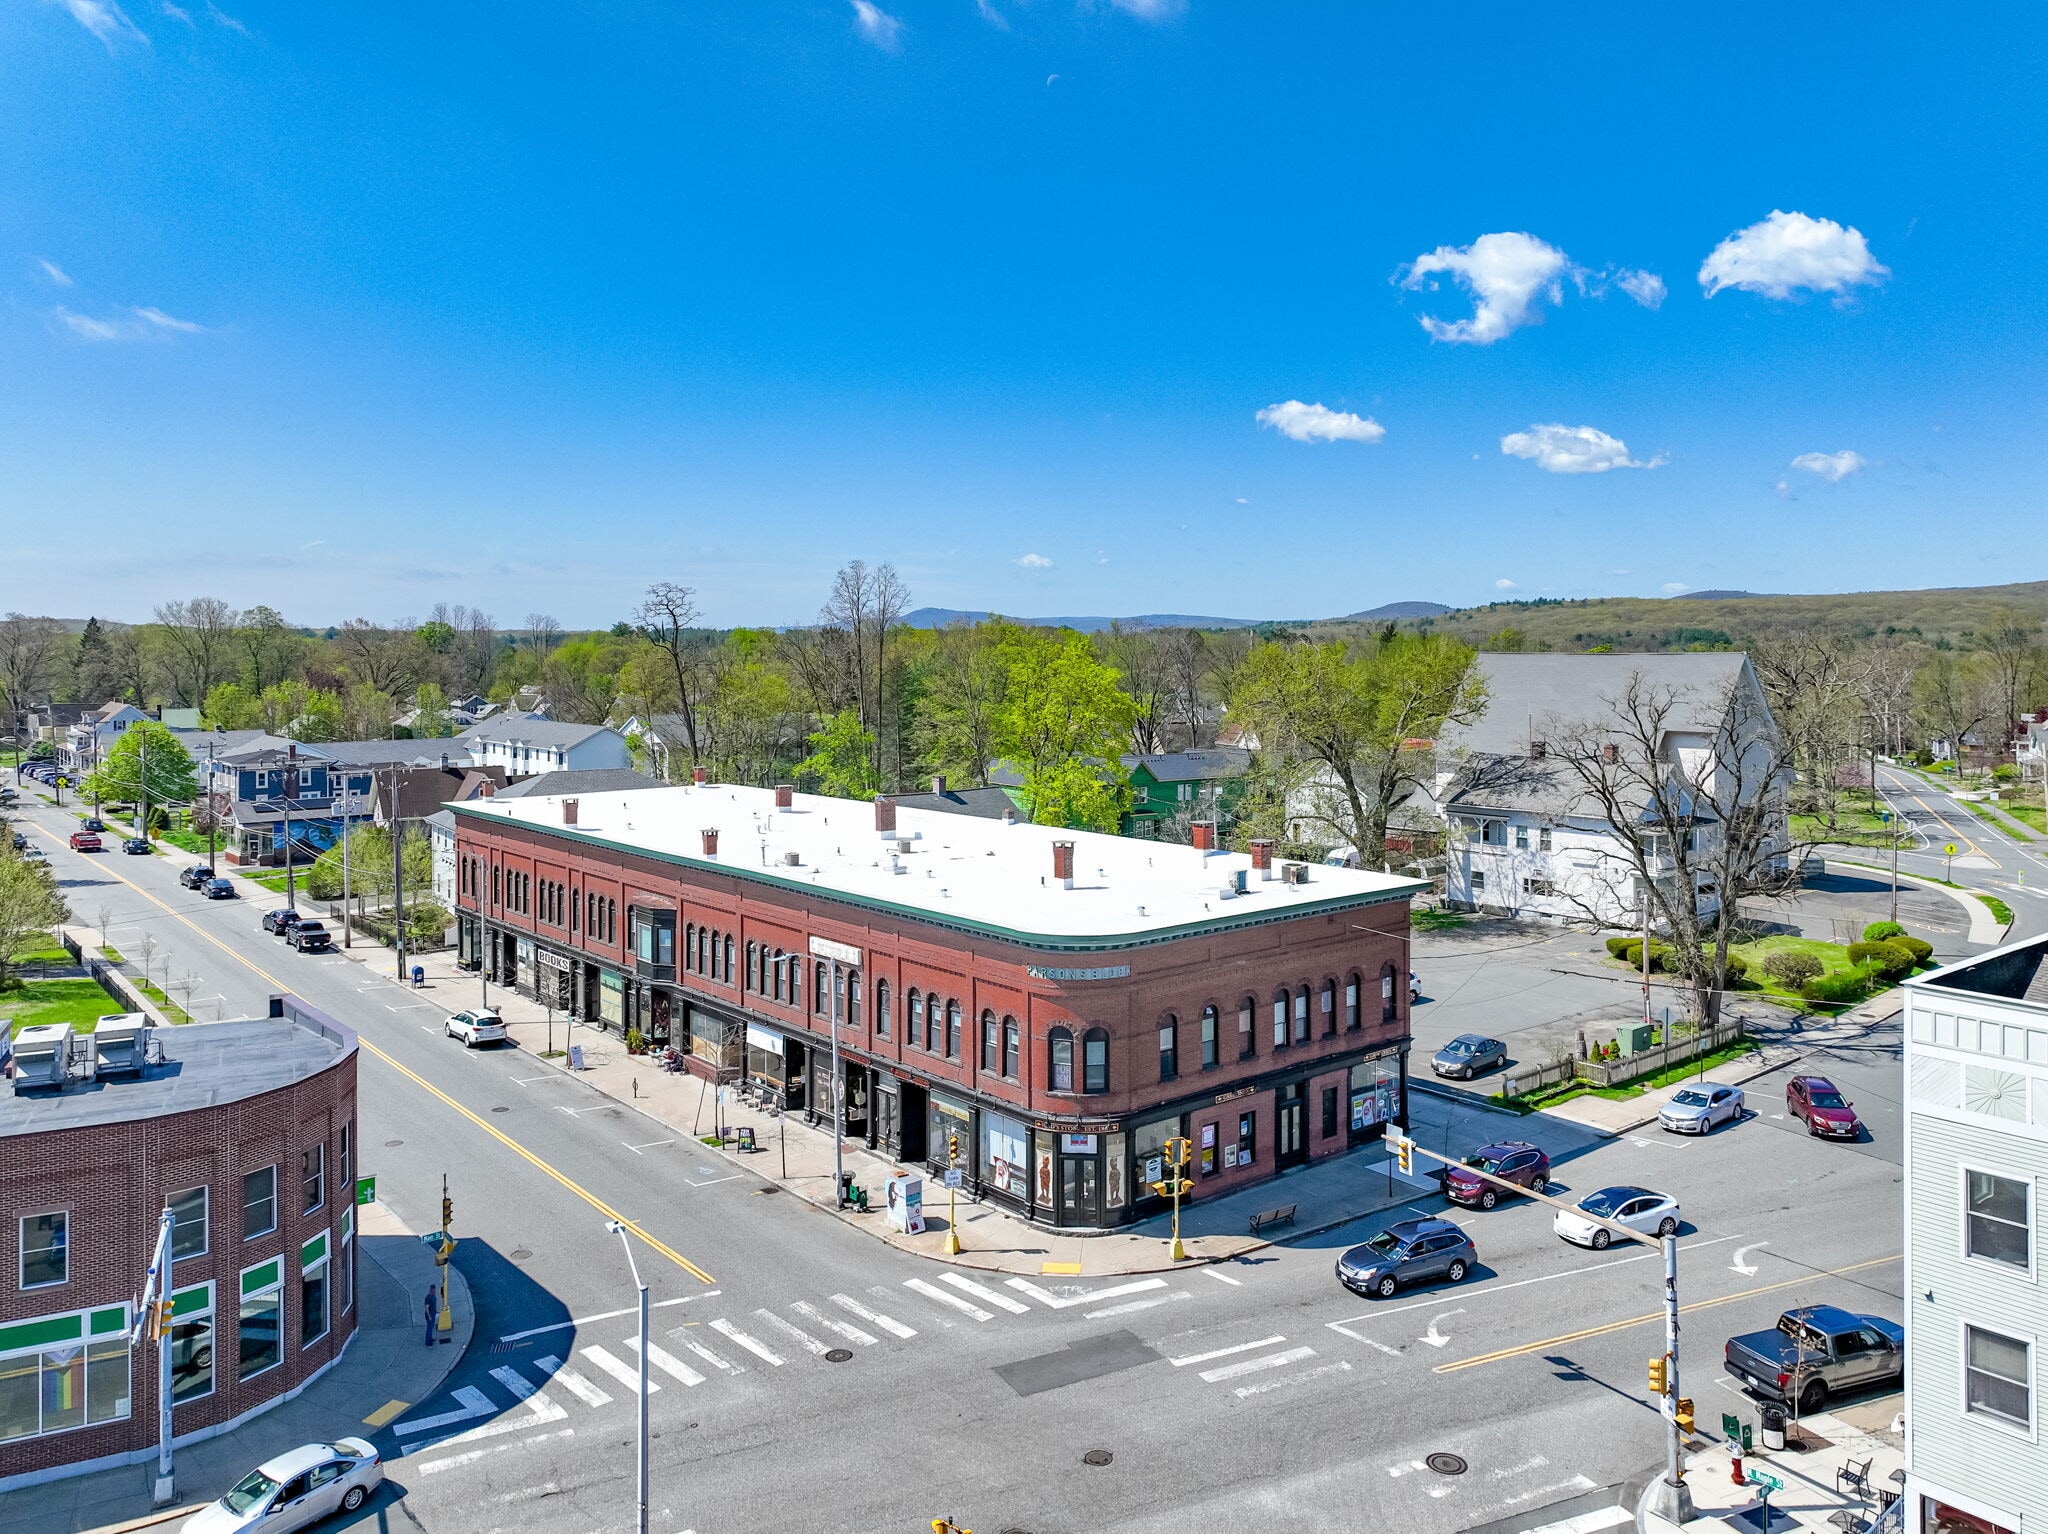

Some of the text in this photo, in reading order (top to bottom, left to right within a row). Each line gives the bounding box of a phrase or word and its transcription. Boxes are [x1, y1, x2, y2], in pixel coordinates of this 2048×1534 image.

[540, 951, 569, 970] BOOKS
[1027, 965, 1086, 979] PARSONS
[1055, 1065, 1071, 1075] FOR
[1055, 1074, 1071, 1085] RENT
[423, 1234, 434, 1242] Main
[1756, 1470, 1773, 1485] Maple
[1776, 1478, 1783, 1489] St
